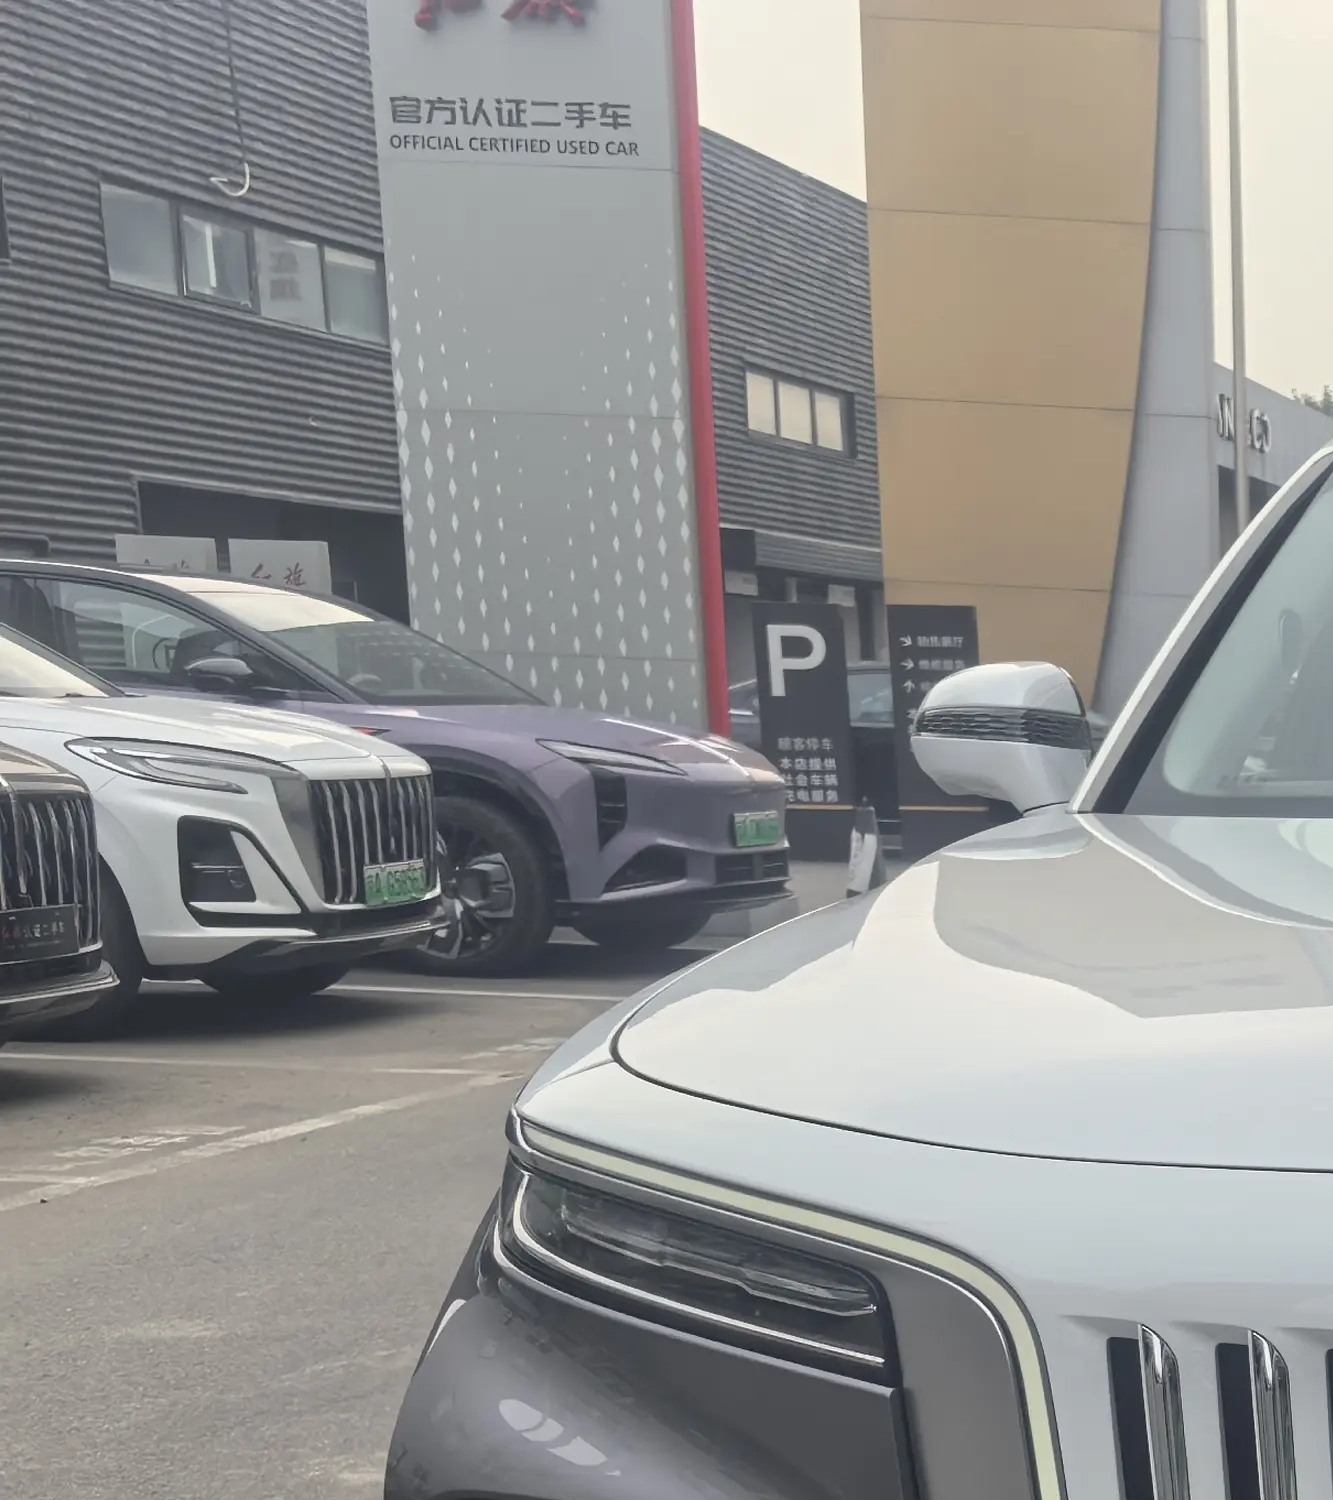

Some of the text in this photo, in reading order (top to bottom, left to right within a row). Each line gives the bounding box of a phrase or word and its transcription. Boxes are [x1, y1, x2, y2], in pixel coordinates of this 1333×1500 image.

[389, 95, 632, 130] 官方认证二手车
[389, 134, 640, 157] OFFICIAL CERTIFIED USED CAR
[766, 623, 827, 697] P
